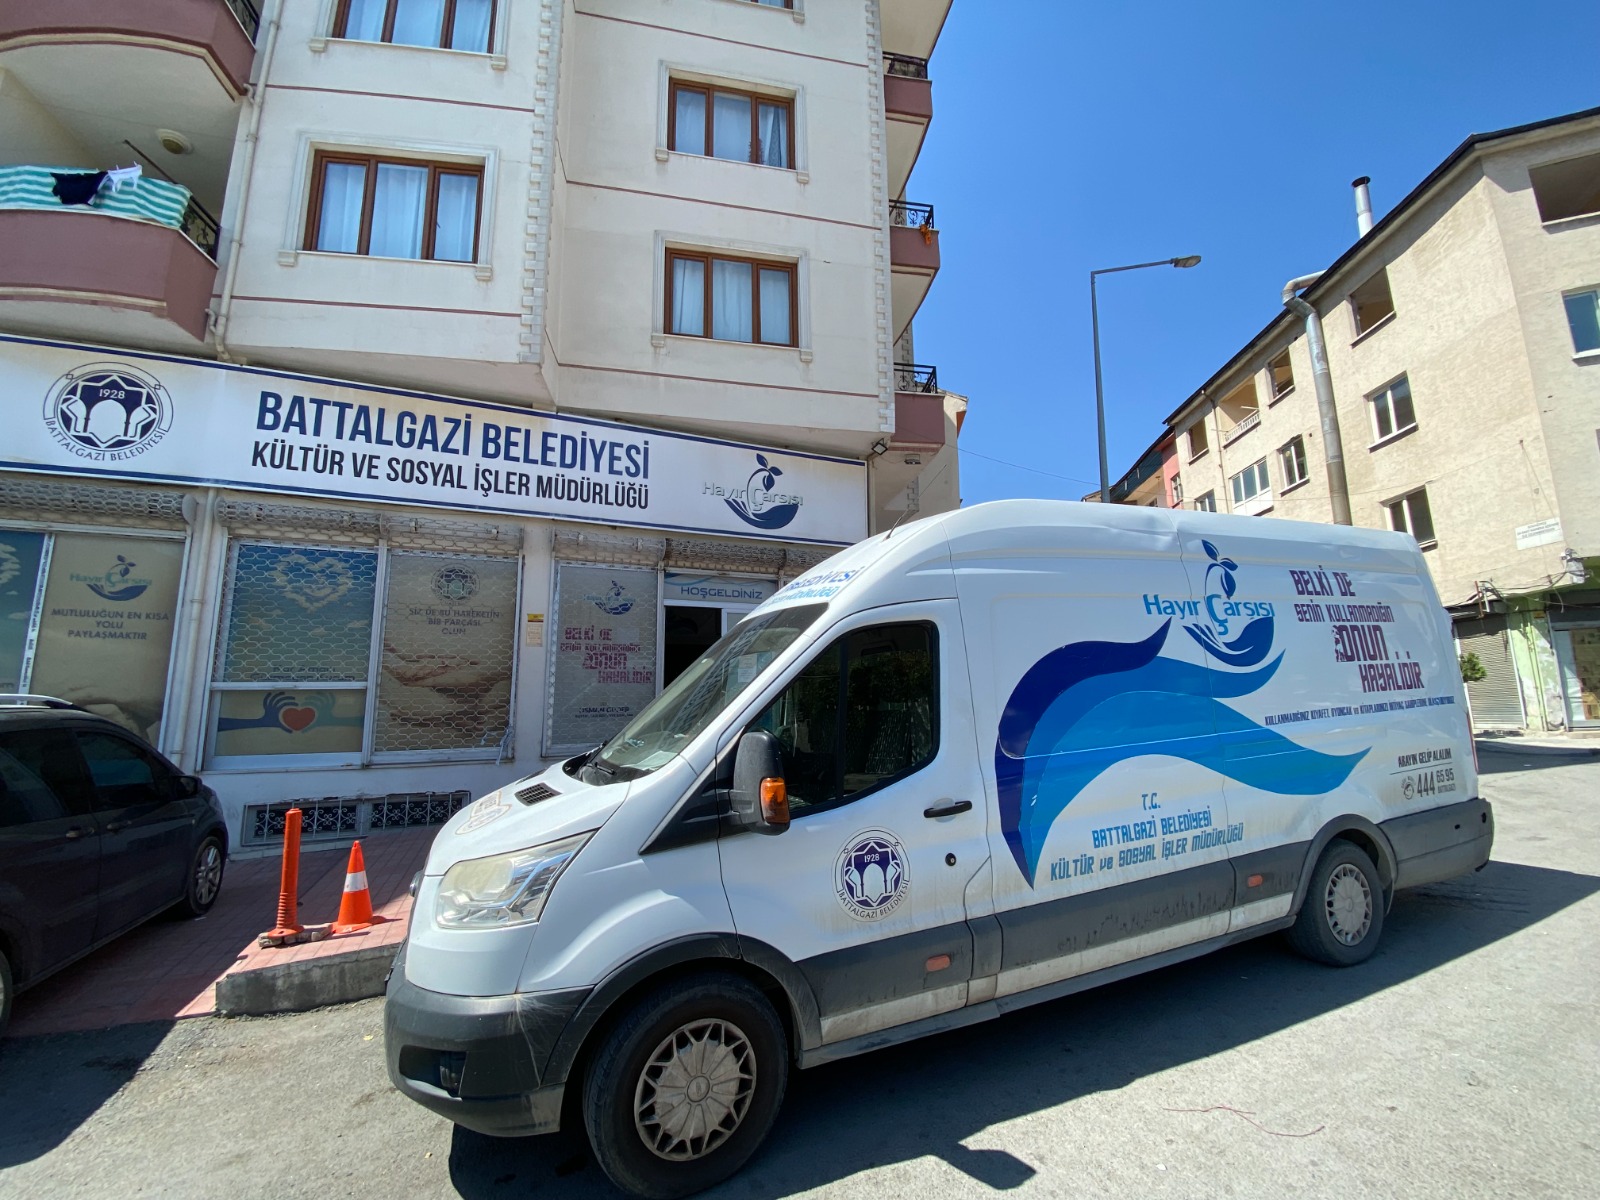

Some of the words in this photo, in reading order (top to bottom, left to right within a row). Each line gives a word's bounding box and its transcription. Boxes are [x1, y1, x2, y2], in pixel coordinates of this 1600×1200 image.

[99, 387, 126, 401] 1928
[45, 417, 107, 462] BATTALGAZİ
[110, 429, 167, 462] BELEDİYESİ
[256, 390, 472, 456] BATTALGAZİ
[481, 421, 650, 480] BELEDİYESİ
[252, 440, 345, 476] KÜLTÜR
[351, 453, 380, 480] VE
[386, 457, 468, 490] SOSYAL
[473, 467, 531, 499] İŞLER
[535, 472, 649, 510] MÜDÜRLÜĞÜ
[680, 583, 764, 601] HOŞGELDİNİZ
[1289, 564, 1335, 596] BELKİ
[1332, 571, 1356, 597] DE
[51, 607, 124, 620] MUTLULUĞUN
[127, 611, 143, 620] EN
[145, 612, 169, 621] KISA
[1143, 593, 1201, 620] Hayır
[1293, 599, 1326, 623] SENİN
[1325, 601, 1395, 623] KULLANMADIĞIN
[67, 630, 147, 641] PAYLAŞMAKTIR
[95, 620, 124, 629] YOLU
[1333, 624, 1390, 662] ONUN
[1358, 650, 1425, 694] HAYALİDİR
[1417, 771, 1435, 798] 444
[1142, 792, 1161, 811] T.C.
[1091, 815, 1158, 849] BATTALGAZİ
[1160, 805, 1213, 836] BELEDİYESİ
[864, 853, 880, 863] 1928
[1050, 854, 1095, 881] KÜLTÜR
[1099, 857, 1114, 872] ve
[1119, 844, 1157, 867] SOSYAL
[1161, 838, 1188, 861] İŞLER
[1191, 822, 1244, 852] MÜDÜRLÜĞÜ
[838, 889, 878, 919] BATTALGAZİ
[879, 880, 910, 917] BELEDİYESİ
